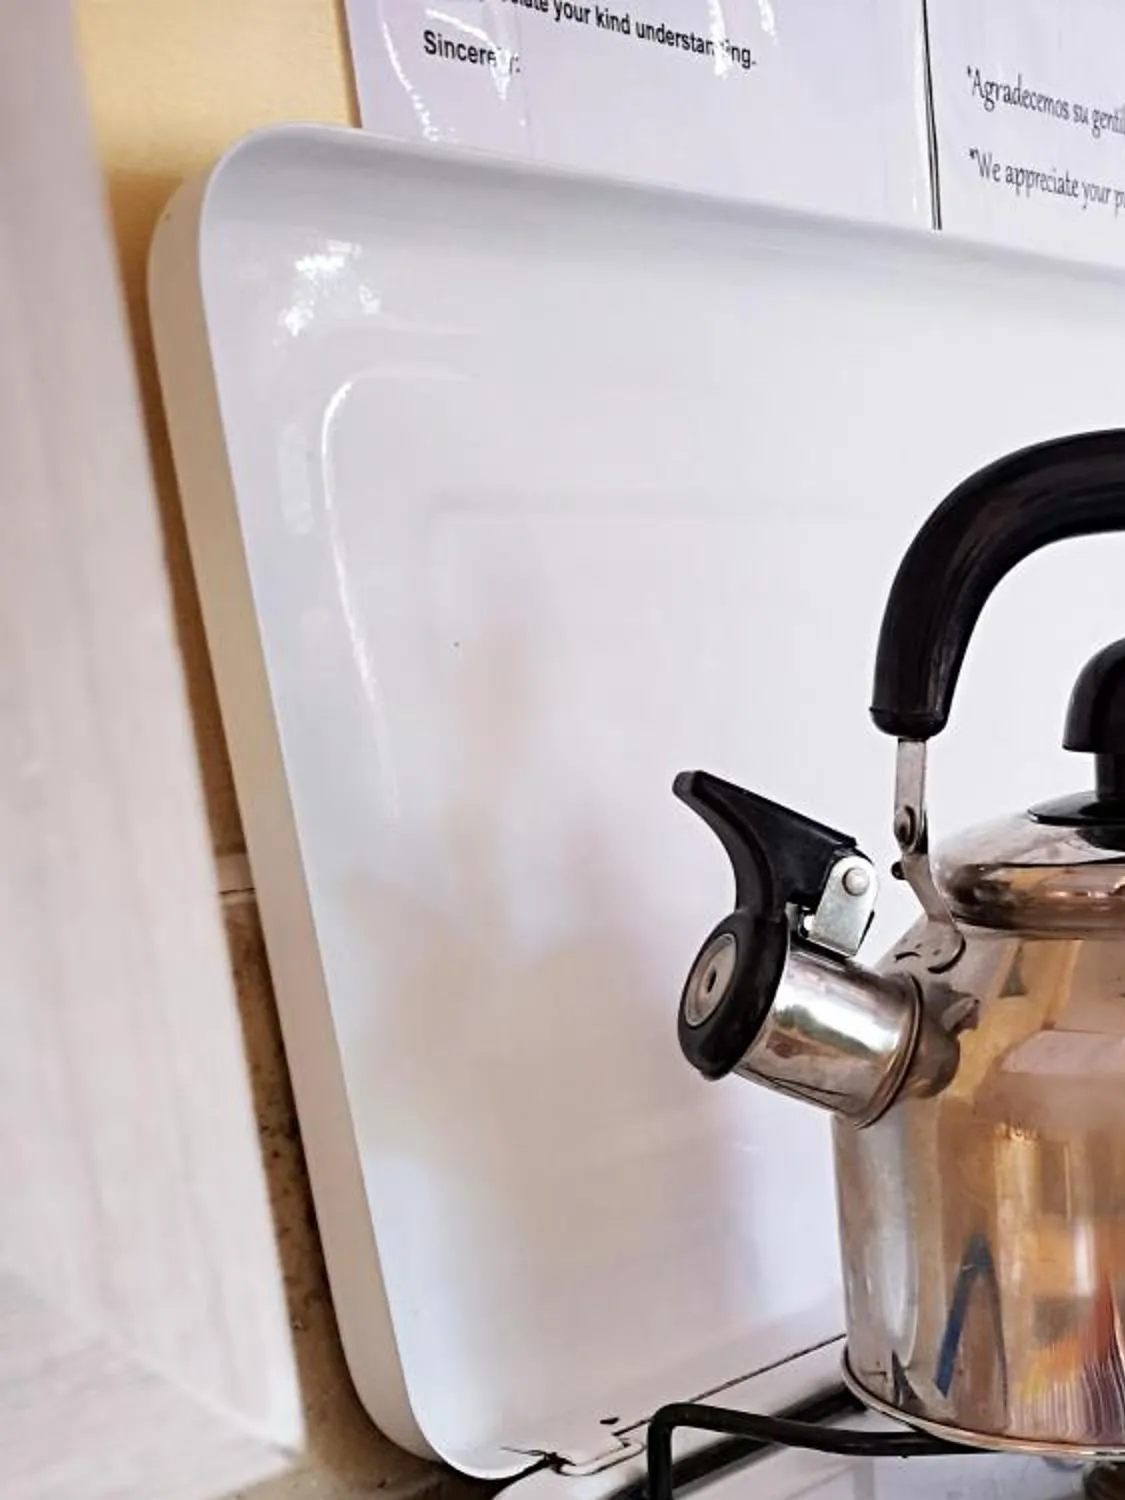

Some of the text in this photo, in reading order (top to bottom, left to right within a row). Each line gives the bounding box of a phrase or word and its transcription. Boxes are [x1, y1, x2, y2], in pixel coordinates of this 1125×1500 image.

[553, 0, 591, 24] your
[595, 5, 631, 35] kind
[423, 29, 521, 74] Sincere:
[1005, 165, 1079, 199] appreciate
[1081, 181, 1112, 210] your
